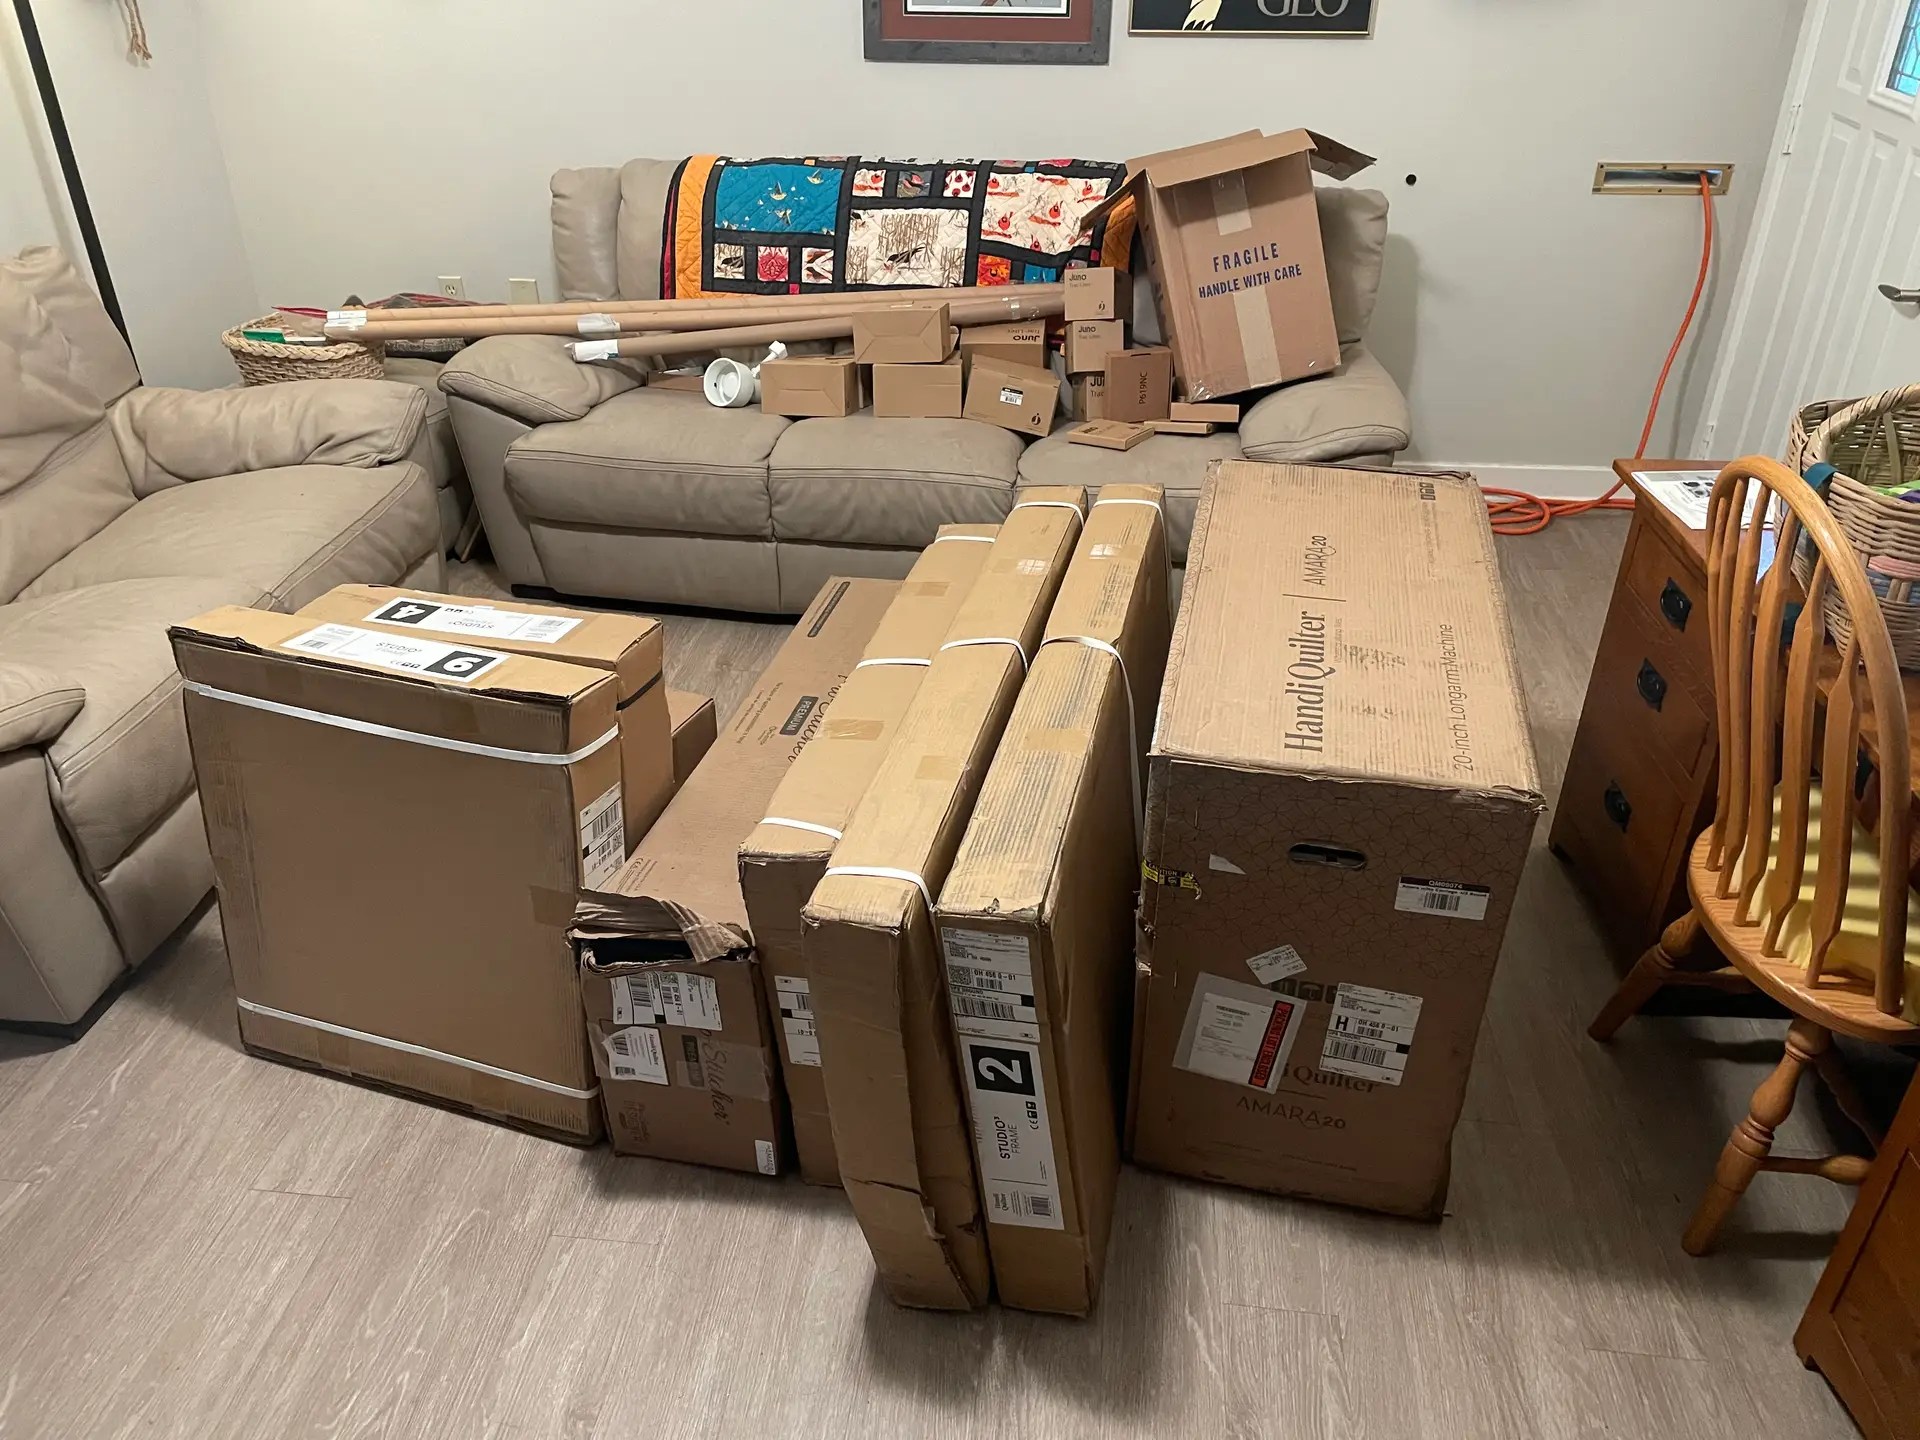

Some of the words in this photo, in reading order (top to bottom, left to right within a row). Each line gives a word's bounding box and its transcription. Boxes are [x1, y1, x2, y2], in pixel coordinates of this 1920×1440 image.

[1213, 242, 1280, 273] FRAGILE
[1069, 273, 1087, 281] Juno
[1198, 278, 1240, 299] HANDLE
[1242, 271, 1271, 289] WITH
[1274, 264, 1302, 281] CARE
[1078, 325, 1097, 333] Juno
[1138, 372, 1148, 405] P619NC
[391, 602, 427, 620] 4
[1438, 624, 1454, 668] Machine
[443, 656, 483, 673] 6
[1444, 668, 1468, 721] Longarm
[787, 699, 812, 731] PREMIUM
[1451, 723, 1473, 771] 20-inch
[1335, 1015, 1349, 1031] H
[978, 1056, 1023, 1085] 2
[1010, 1123, 1019, 1154] FRAME
